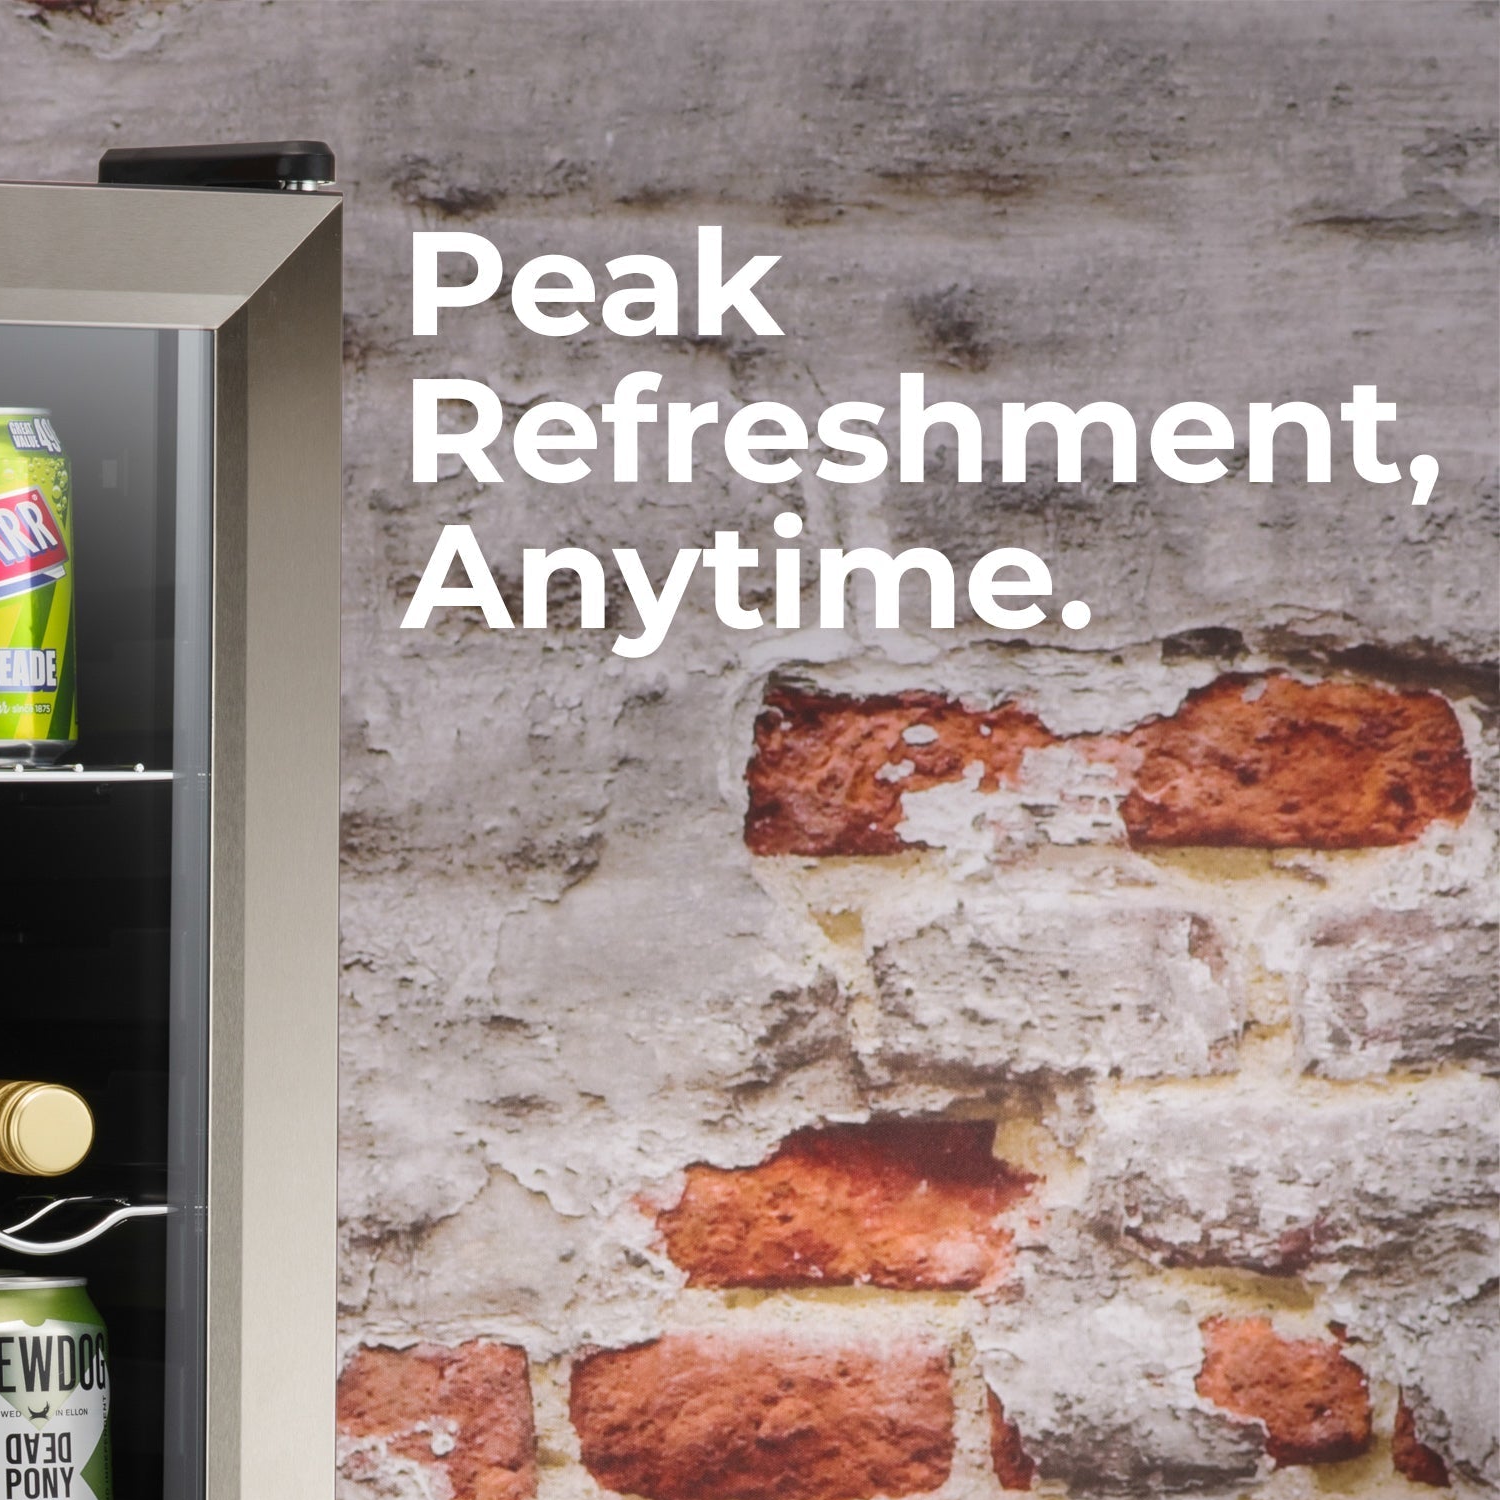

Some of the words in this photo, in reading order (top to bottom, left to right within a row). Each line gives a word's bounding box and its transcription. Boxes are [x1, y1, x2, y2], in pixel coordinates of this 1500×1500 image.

[55, 1409, 64, 1417] IN
[65, 1408, 89, 1417] ELLON
[6, 1432, 72, 1464] DEAD
[6, 1466, 74, 1500] PONY
